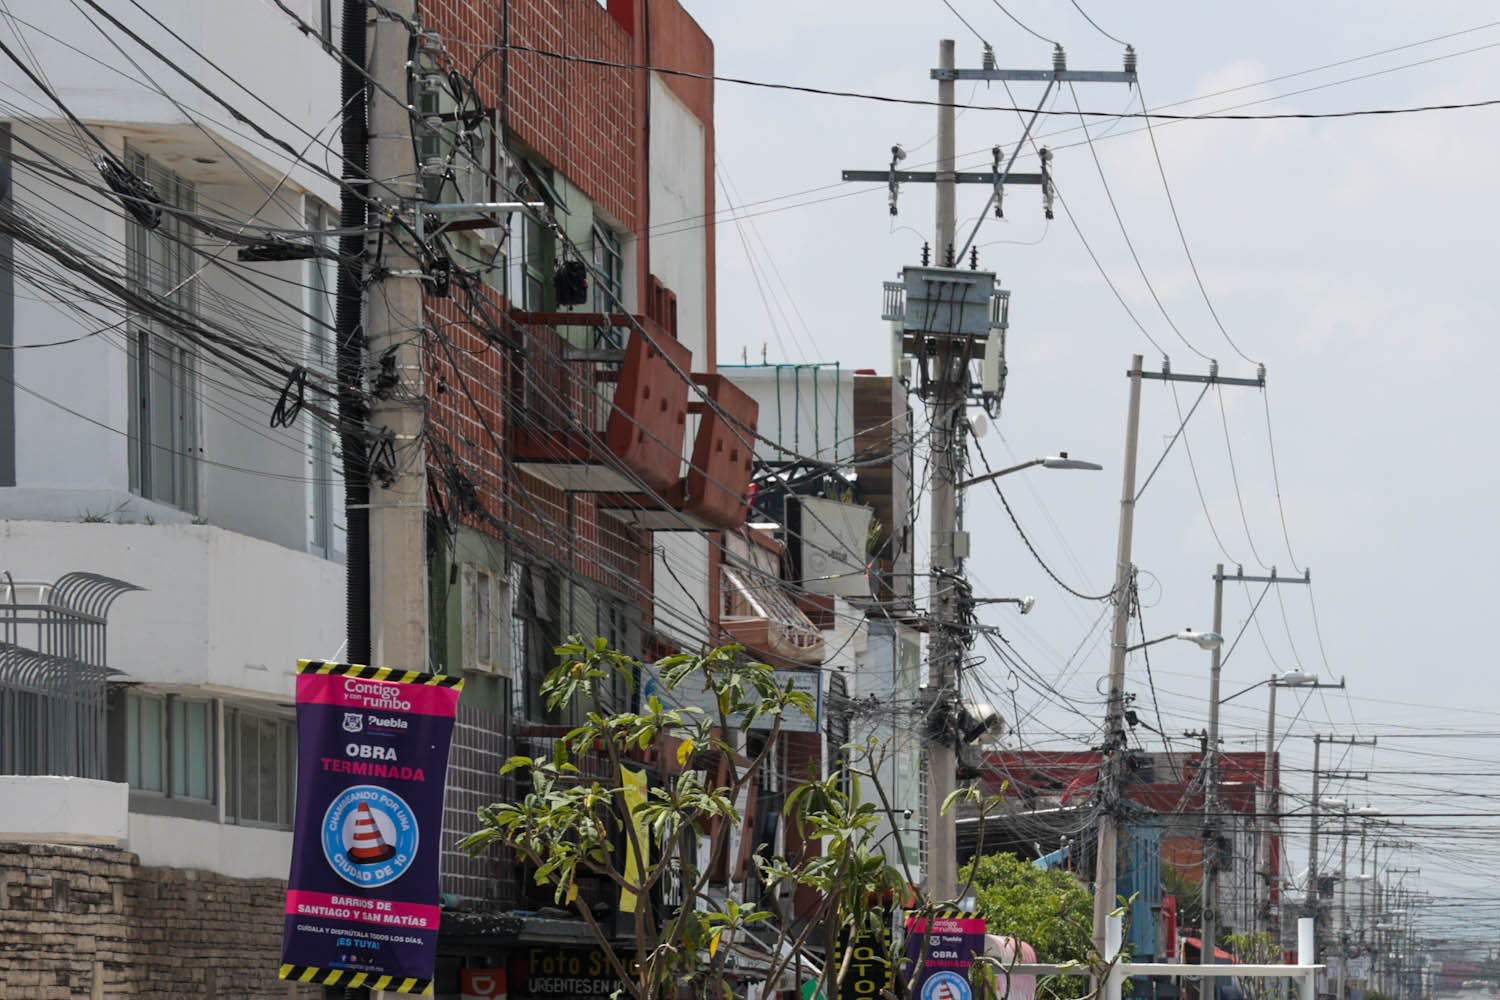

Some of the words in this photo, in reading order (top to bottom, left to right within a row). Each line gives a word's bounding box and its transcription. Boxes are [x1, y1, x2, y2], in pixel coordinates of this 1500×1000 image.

[344, 679, 400, 699] Contigo
[363, 696, 411, 710] rumbo
[368, 716, 408, 729] Puebla
[346, 744, 398, 760] OBRA
[321, 758, 424, 782] TERMINADA
[380, 795, 400, 812] POR
[397, 810, 410, 832] UNA
[334, 853, 372, 880] CIUDAD
[376, 865, 394, 880] DE
[394, 854, 407, 866] 10
[331, 896, 374, 909] BARRIOS
[376, 901, 392, 911] DE
[298, 904, 350, 918] SANTIAGO
[353, 911, 361, 919] Y
[362, 912, 381, 922] SAN
[384, 914, 427, 927] MATÍAS
[390, 934, 404, 942] LOS
[529, 978, 592, 994] URGENTES
